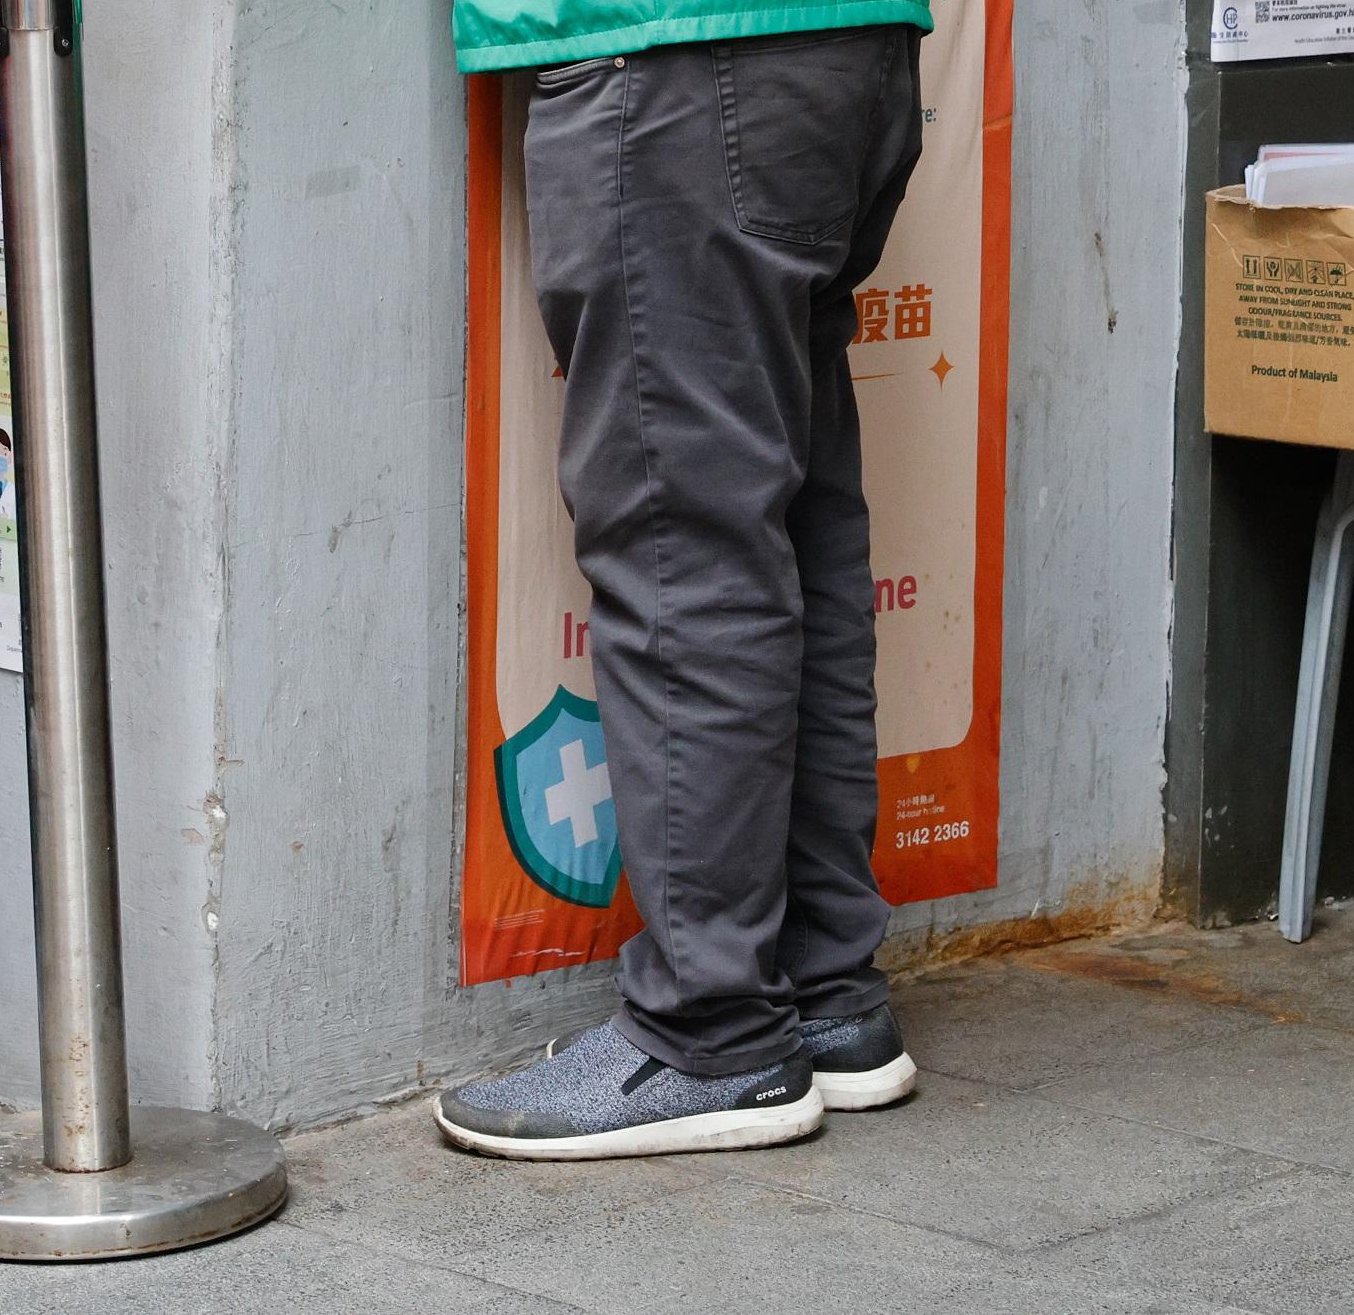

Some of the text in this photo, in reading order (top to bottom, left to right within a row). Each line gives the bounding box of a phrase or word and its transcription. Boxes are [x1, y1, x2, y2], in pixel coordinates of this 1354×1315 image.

[1313, 289, 1333, 298] CLEAN
[1259, 296, 1352, 311] FROM SUNLIGHT STRONG
[853, 283, 933, 344] 疫苗
[1252, 365, 1338, 383] Product of Malaysia
[896, 820, 970, 849] 3142 2366
[756, 1086, 787, 1101] crocs
